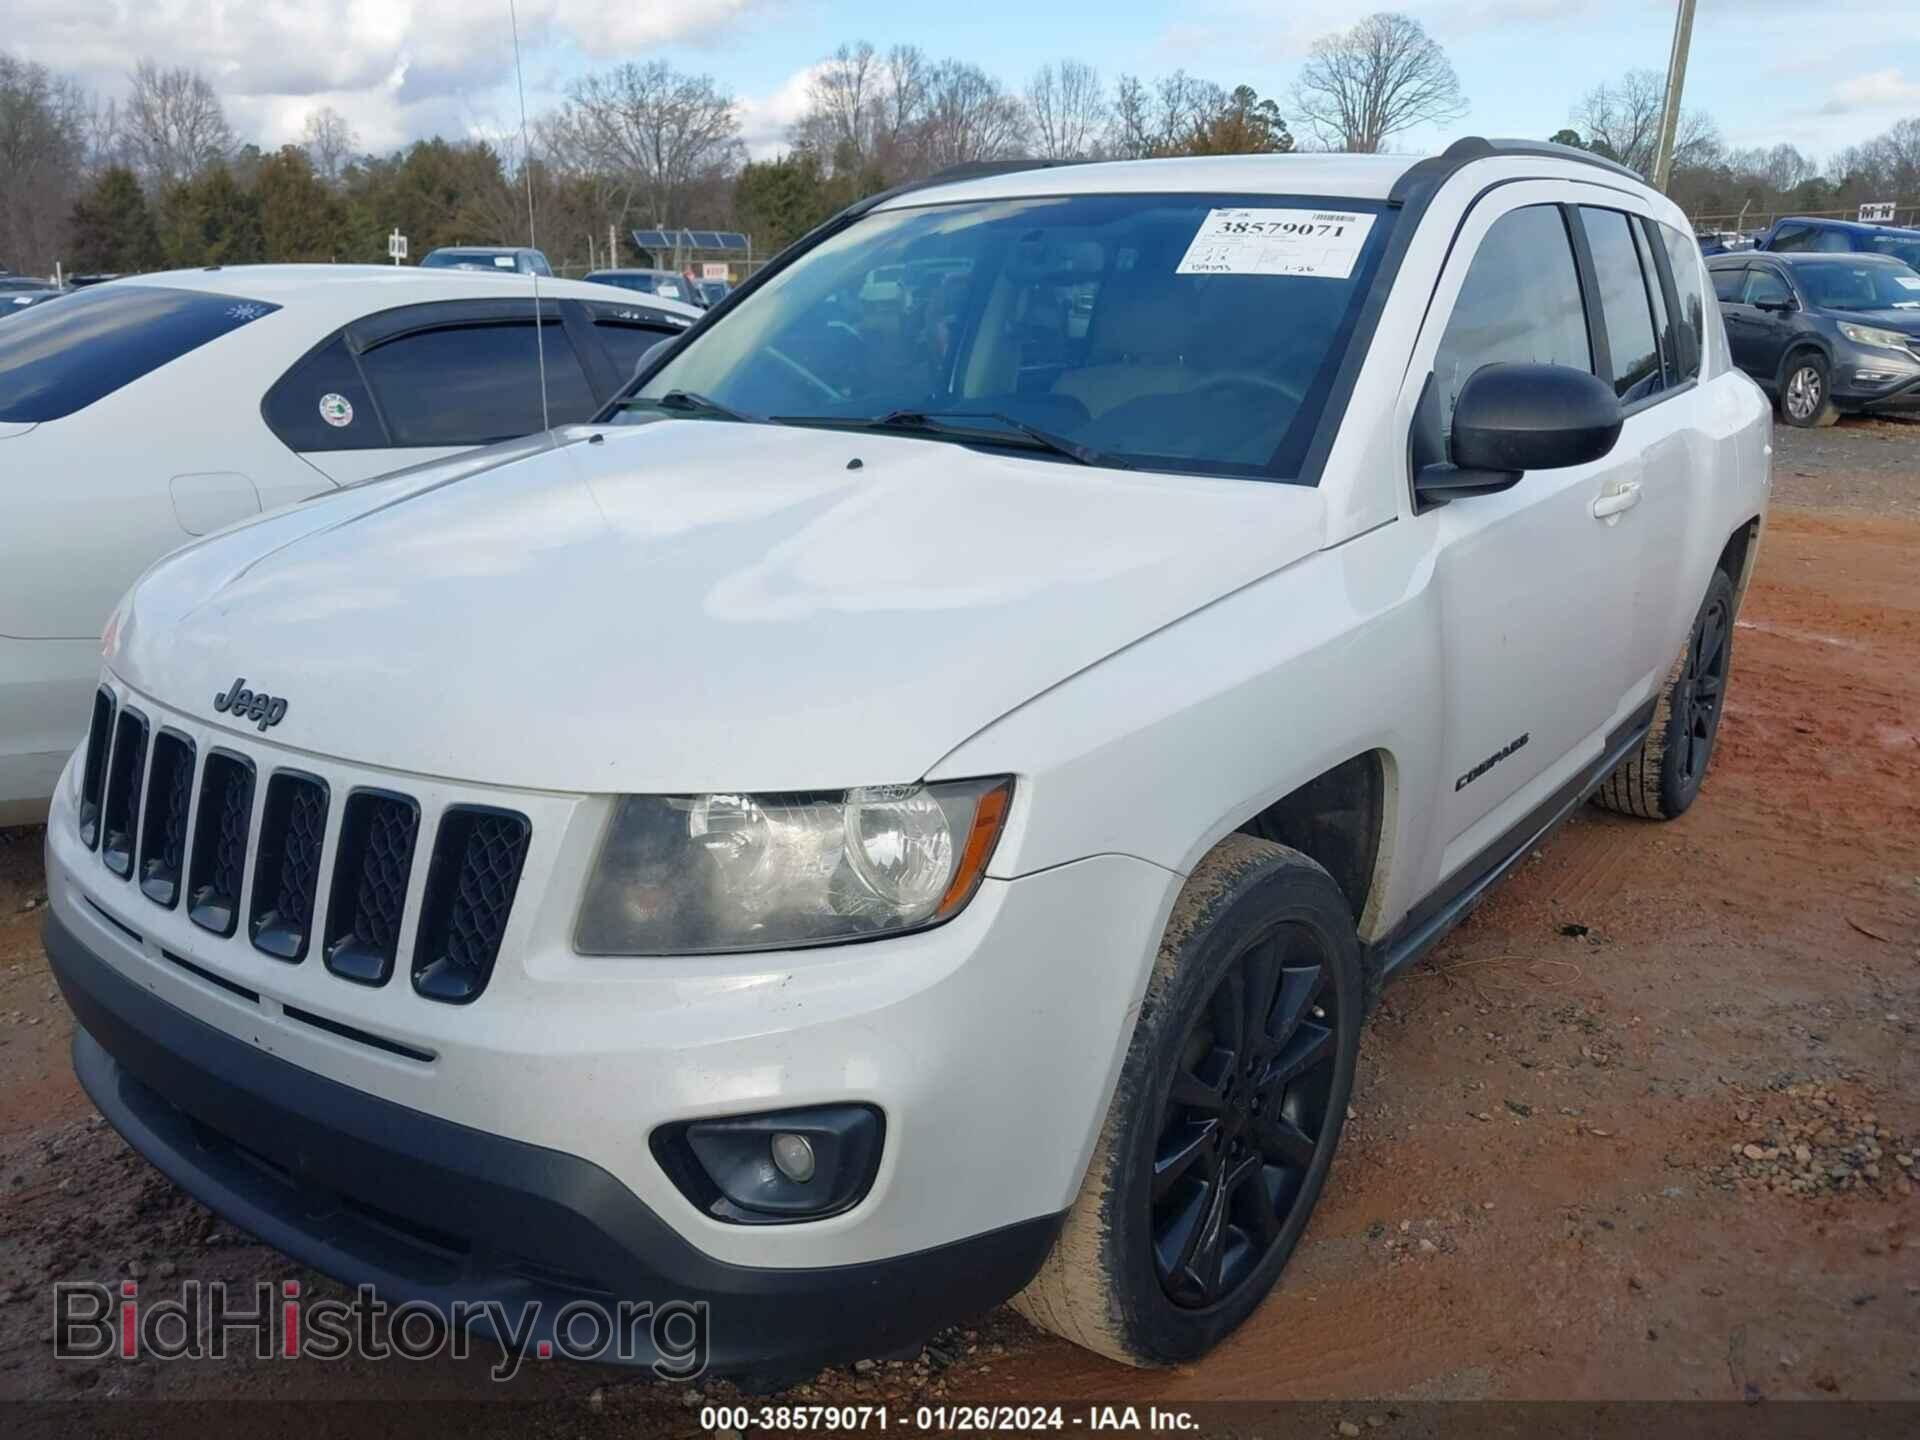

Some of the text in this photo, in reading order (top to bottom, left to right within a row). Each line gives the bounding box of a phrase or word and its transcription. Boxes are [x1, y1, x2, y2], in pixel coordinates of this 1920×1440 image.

[1216, 221, 1345, 237] 38579071
[213, 677, 288, 732] Jeep
[1455, 732, 1529, 792] COMPASS
